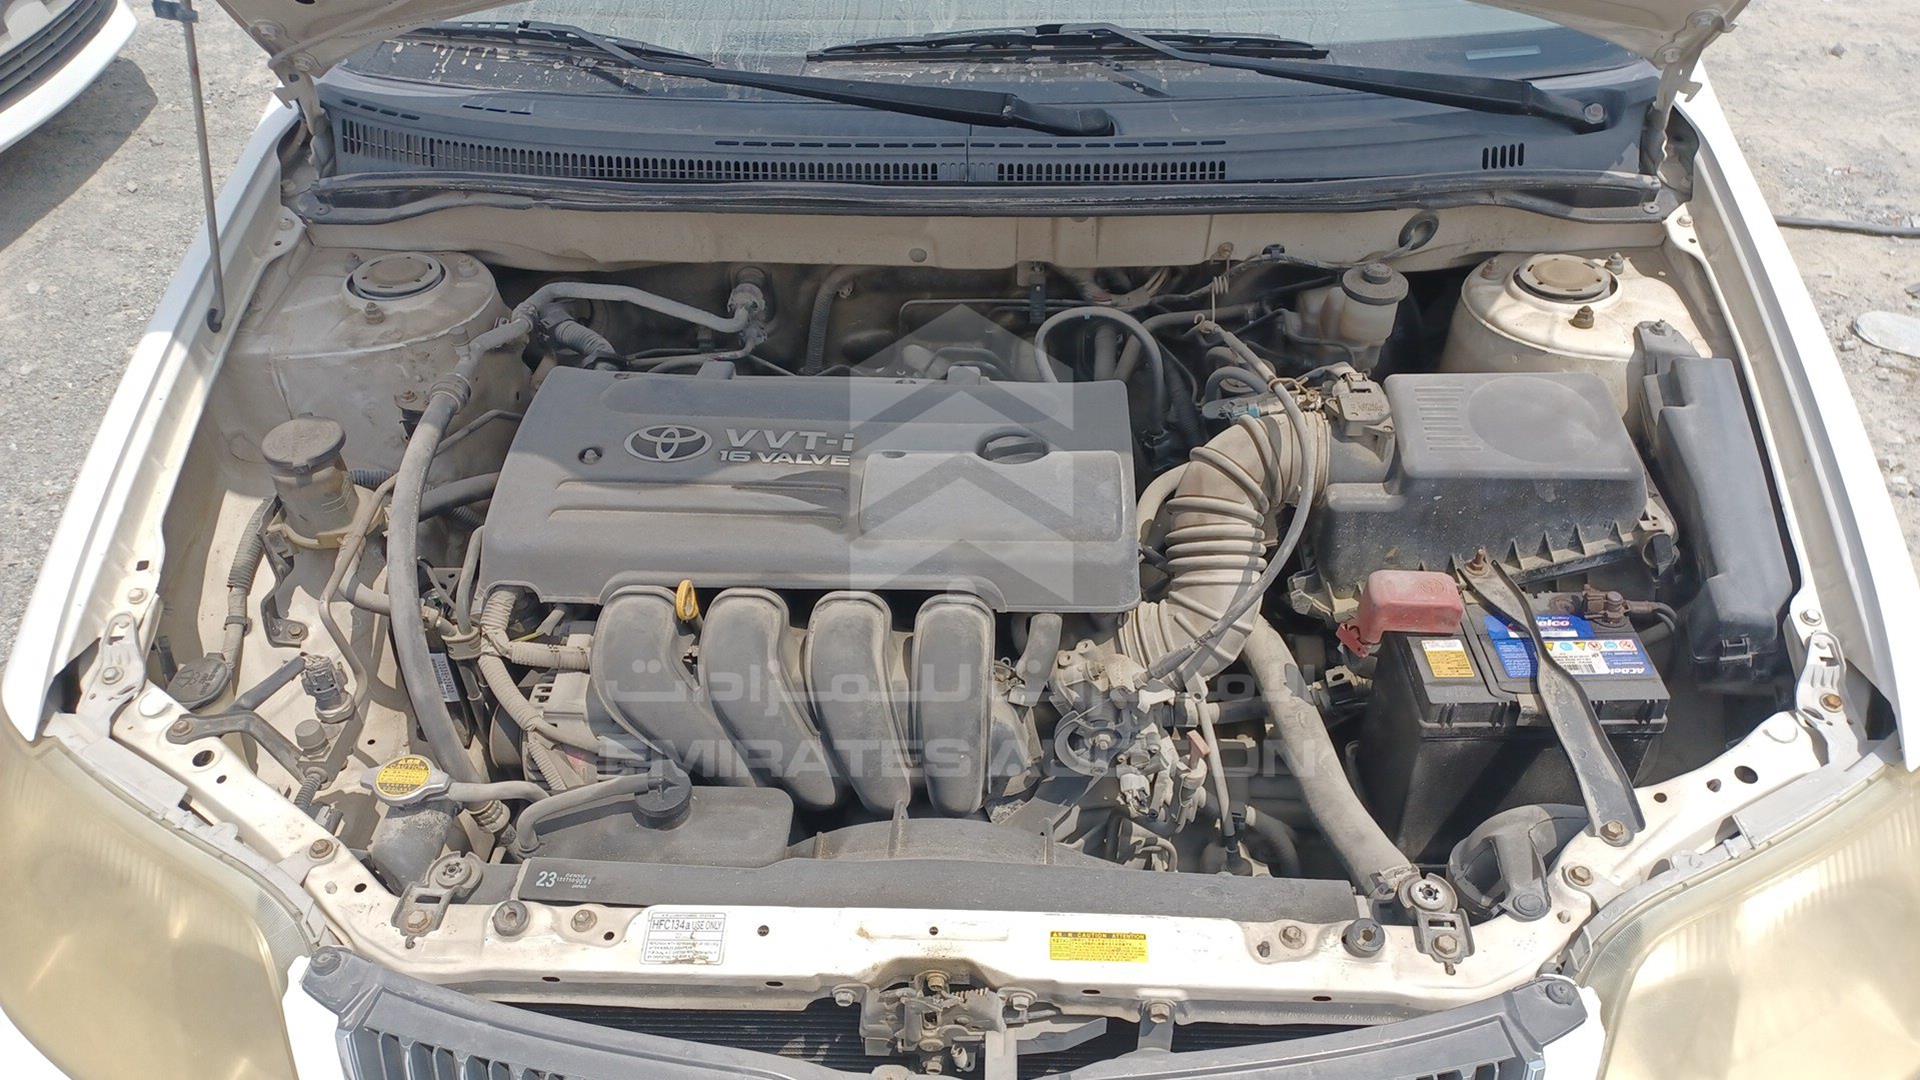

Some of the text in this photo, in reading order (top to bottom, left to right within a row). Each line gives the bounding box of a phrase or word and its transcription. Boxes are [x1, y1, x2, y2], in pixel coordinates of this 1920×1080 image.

[725, 428, 855, 452] VVT-i
[719, 449, 851, 466] 16 VALVE
[1610, 666, 1646, 675] ACDel
[535, 870, 558, 888] 23
[705, 920, 722, 930] ONLY
